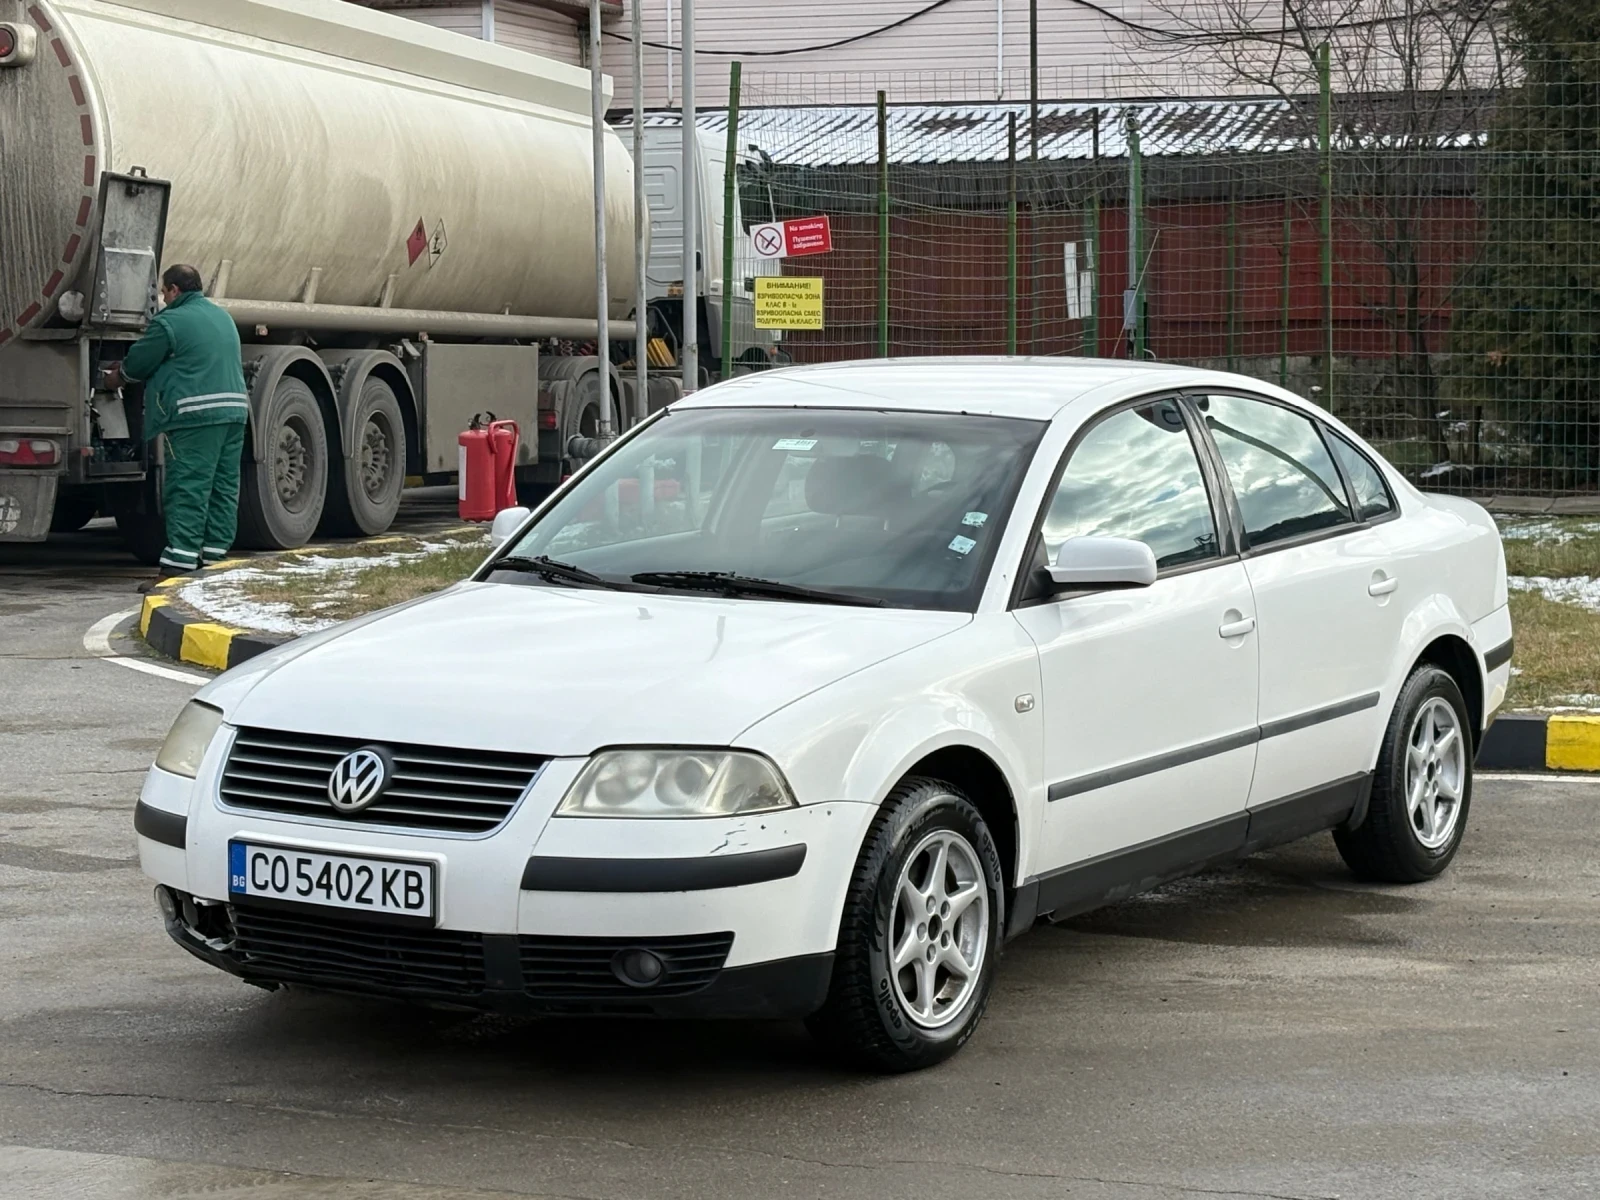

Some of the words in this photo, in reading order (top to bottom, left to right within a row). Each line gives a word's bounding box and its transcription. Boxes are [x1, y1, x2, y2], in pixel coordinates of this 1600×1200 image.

[799, 223, 824, 231] smoking
[232, 874, 245, 887] BG
[983, 832, 1000, 882] apollo
[296, 857, 374, 905] 5402
[381, 867, 425, 910] KB
[879, 978, 902, 1029] apollo
